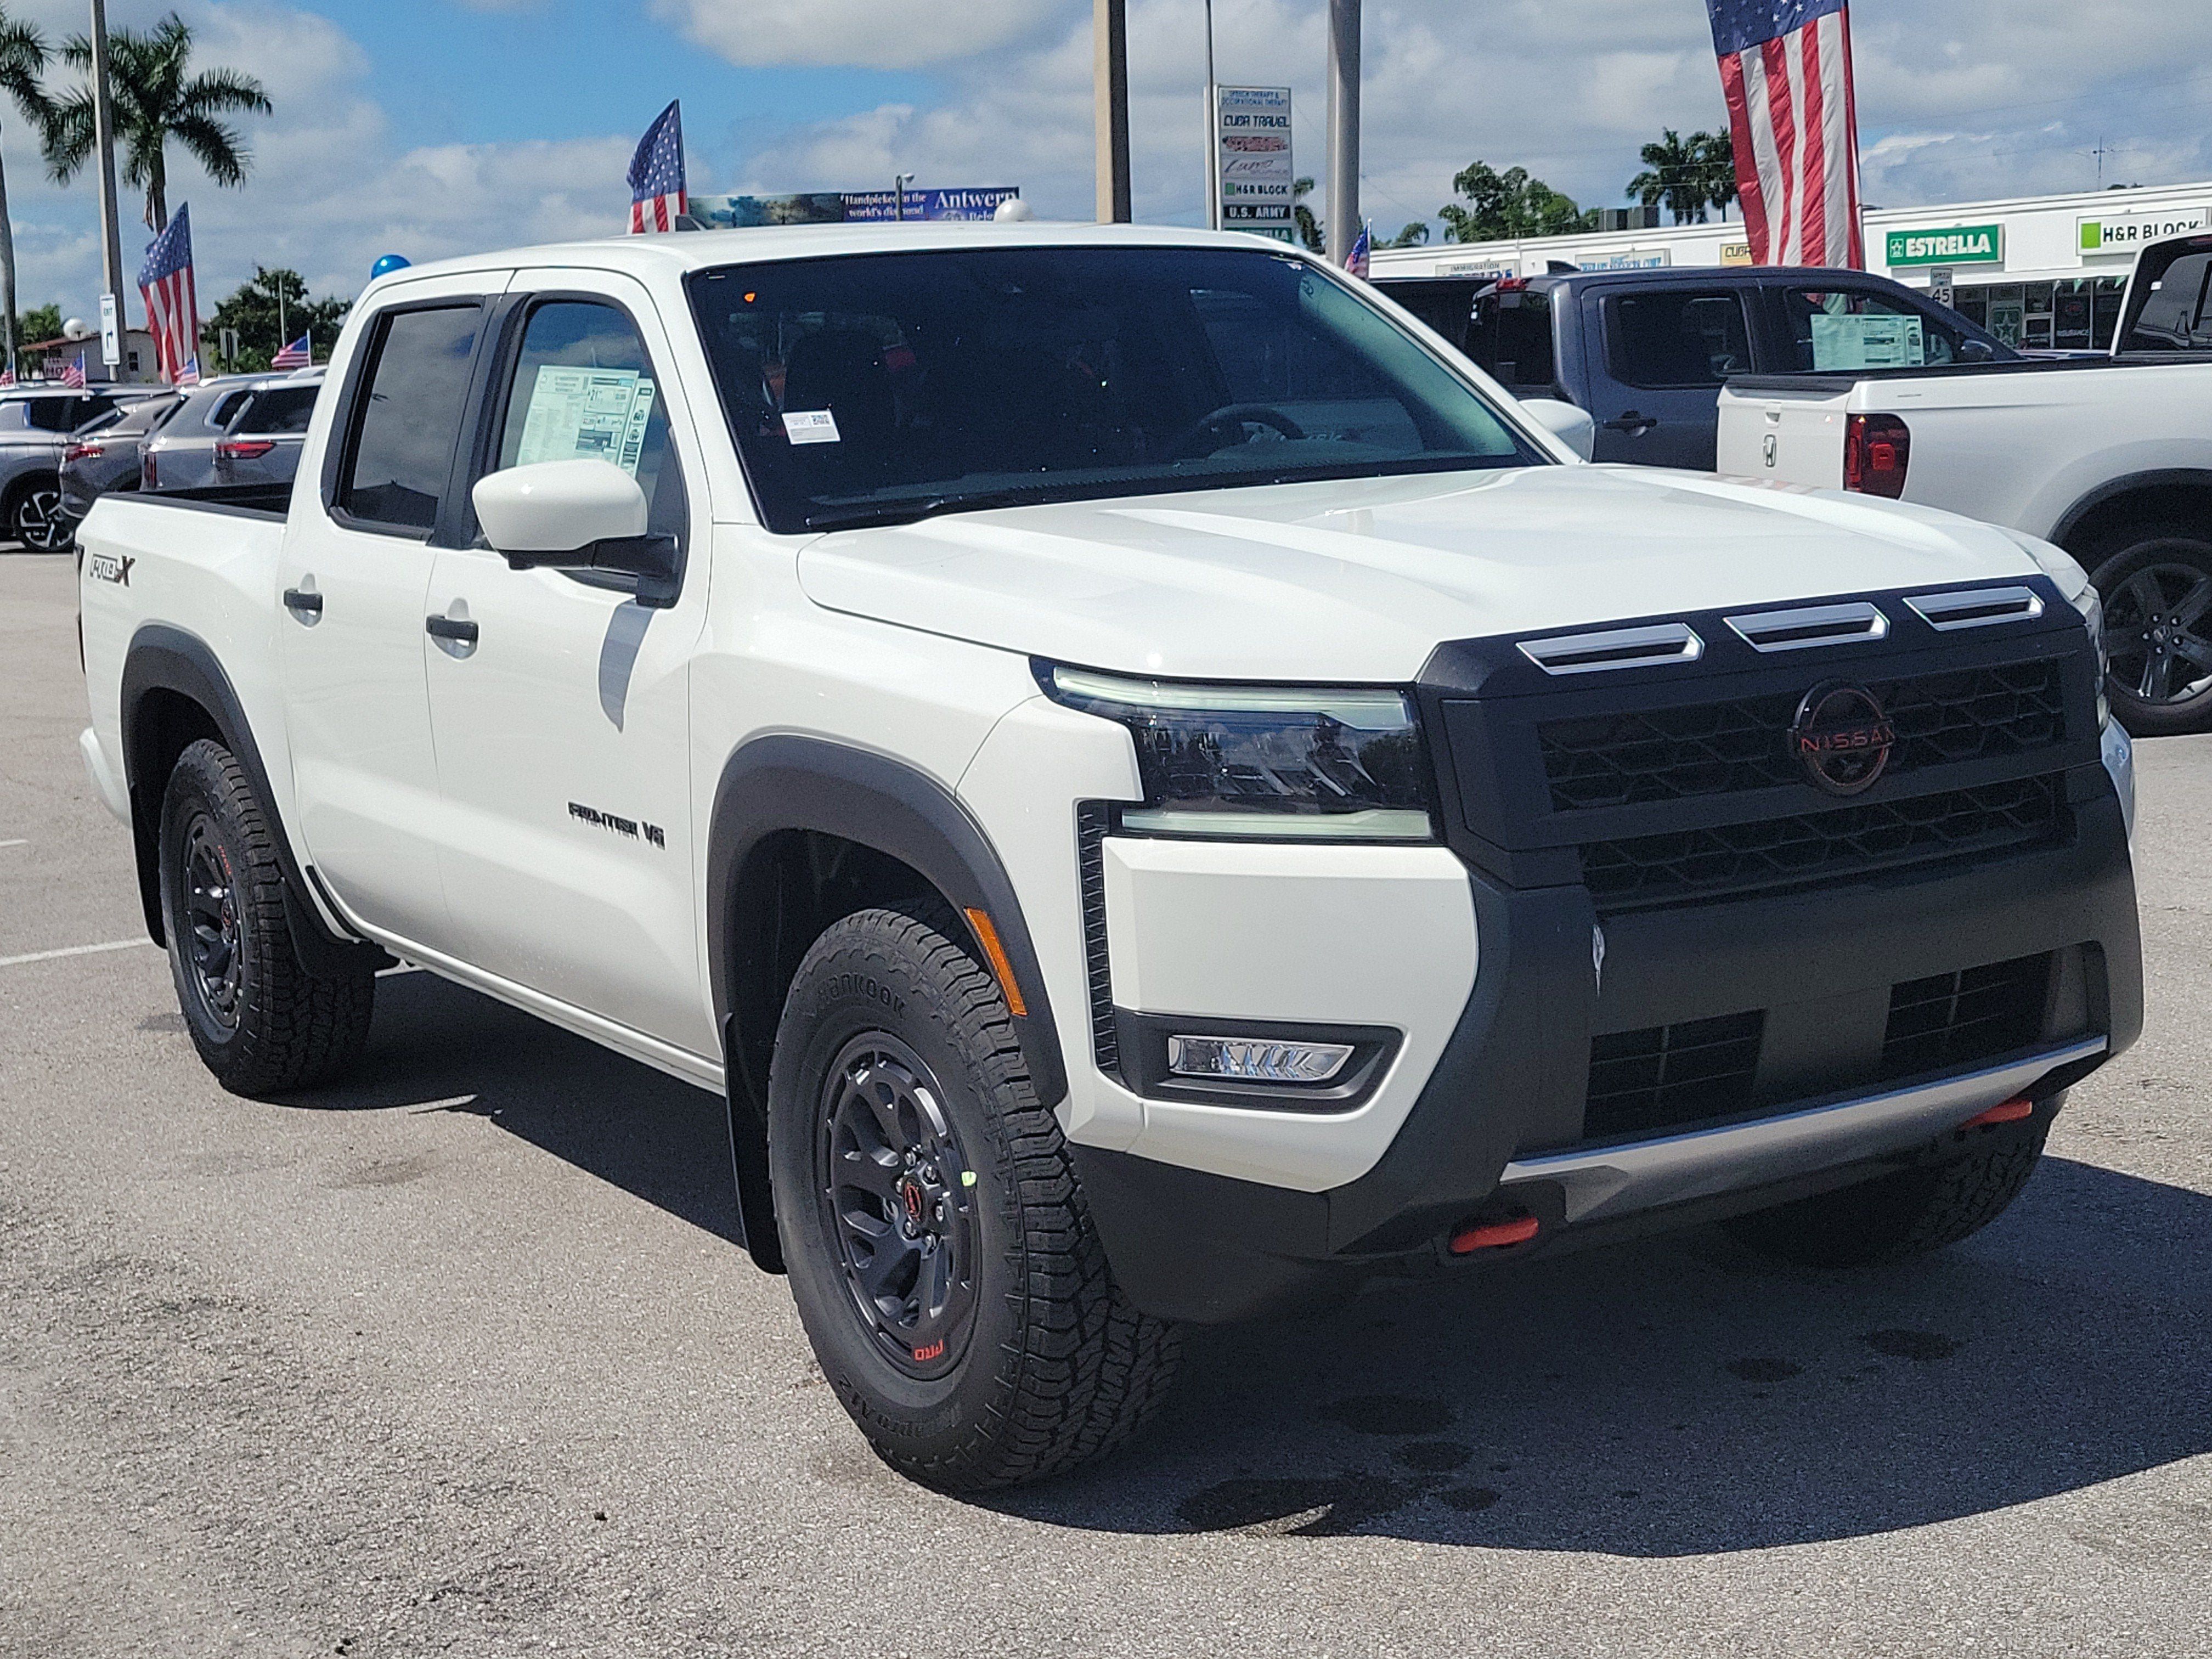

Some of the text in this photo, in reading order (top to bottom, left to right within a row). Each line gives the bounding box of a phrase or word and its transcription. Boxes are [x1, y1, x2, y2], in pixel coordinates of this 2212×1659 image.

[1253, 115, 1290, 127] TRAVEL
[1257, 184, 1288, 195] BLOCK
[1255, 206, 1286, 218] ARMY
[2103, 225, 2137, 242] H&R
[1905, 233, 1992, 257] ESTRELLA
[1932, 288, 1950, 303] 45
[1800, 725, 1895, 753] NISSAN
[915, 1339, 943, 1361] PRO
